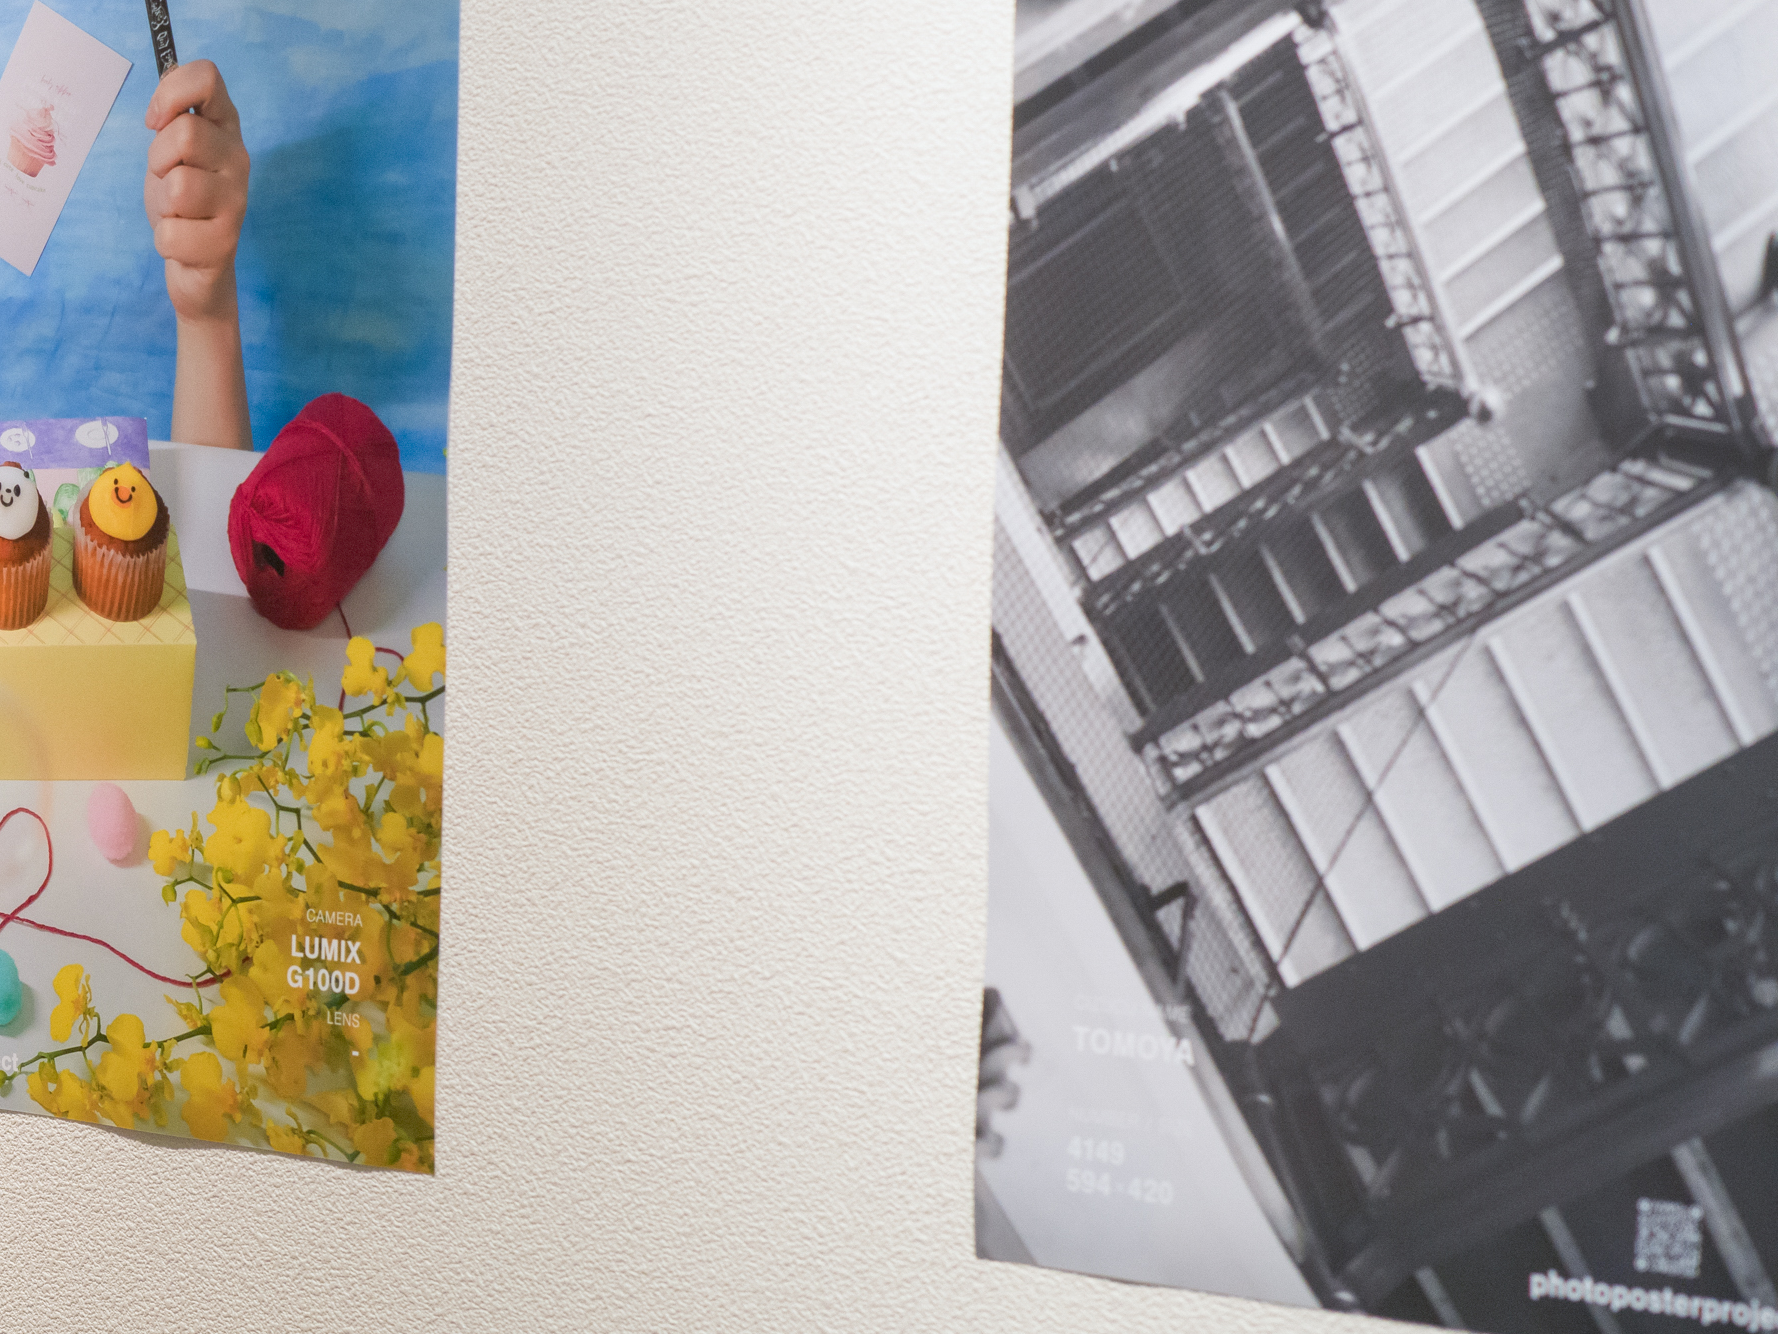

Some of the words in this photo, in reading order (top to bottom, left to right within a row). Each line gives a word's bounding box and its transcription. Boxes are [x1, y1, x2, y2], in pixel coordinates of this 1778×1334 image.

[306, 908, 363, 928] CAMERA
[291, 934, 362, 965] LUMIX
[286, 964, 360, 995] G100D
[326, 1010, 360, 1028] LENS
[1072, 1024, 1195, 1066] TOMOYA
[1067, 1135, 1126, 1167] 4149
[1528, 1268, 1778, 1334] photoposterproje
